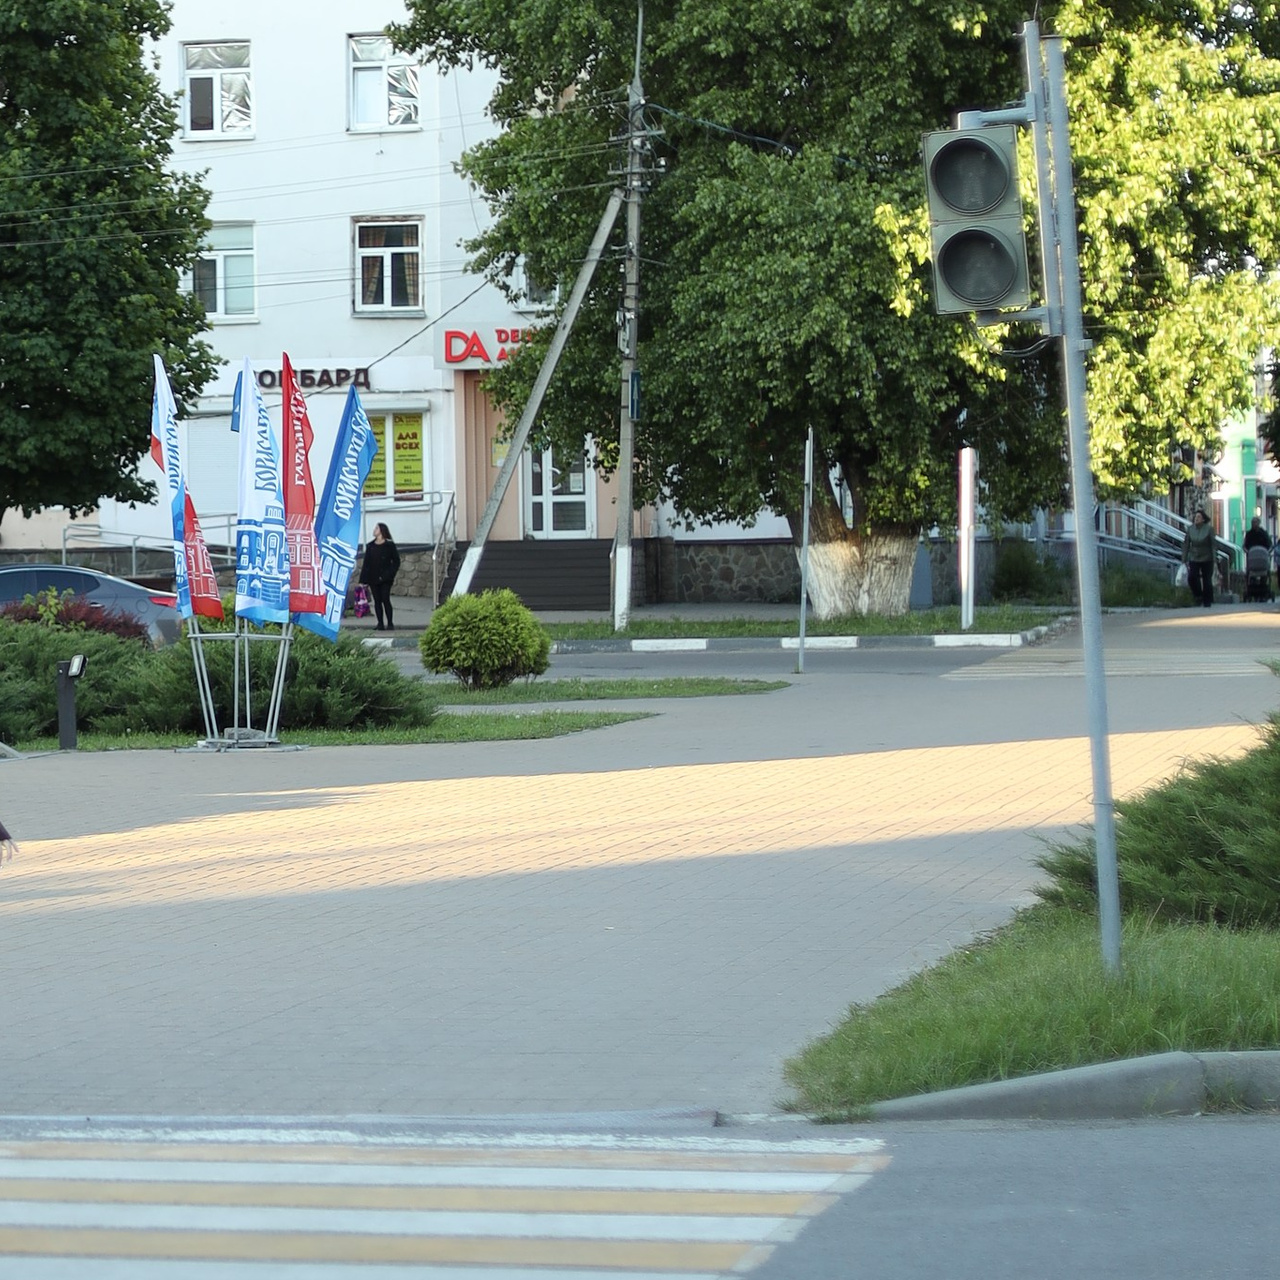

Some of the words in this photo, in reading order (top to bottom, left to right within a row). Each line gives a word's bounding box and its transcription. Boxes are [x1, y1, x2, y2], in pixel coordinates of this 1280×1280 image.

[253, 368, 371, 391] ОБАРД
[397, 431, 418, 441] ДЛЯ
[395, 441, 420, 451] ВСЕХ
